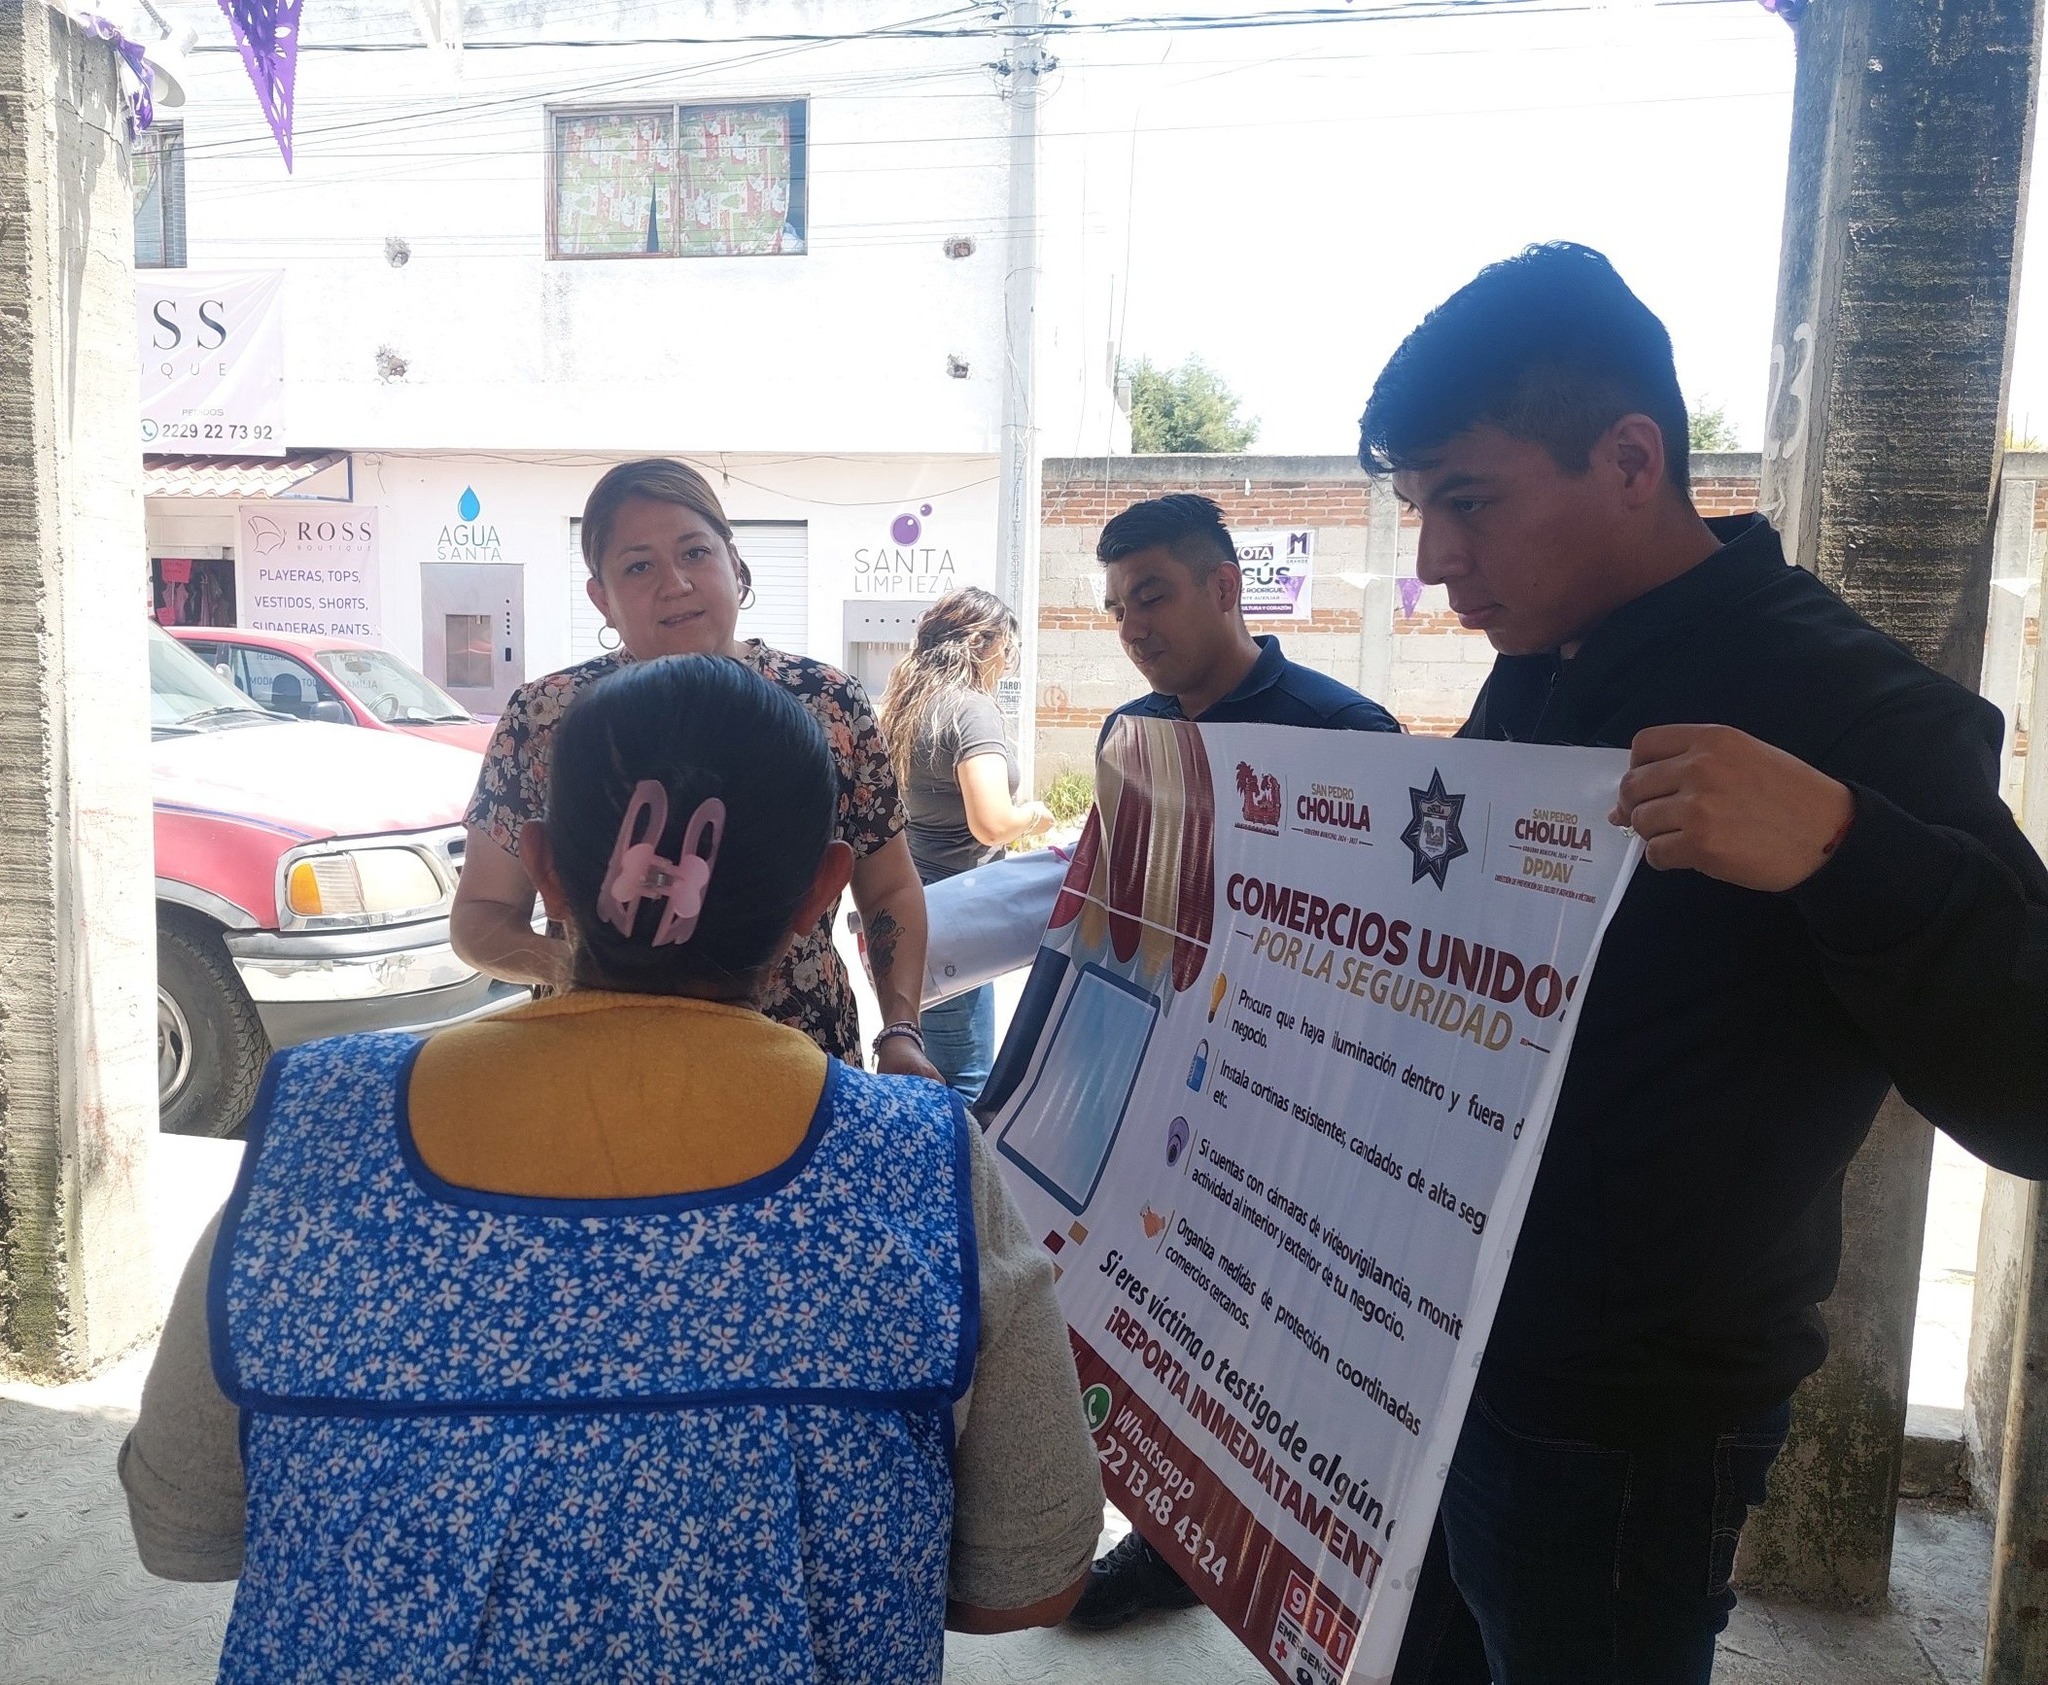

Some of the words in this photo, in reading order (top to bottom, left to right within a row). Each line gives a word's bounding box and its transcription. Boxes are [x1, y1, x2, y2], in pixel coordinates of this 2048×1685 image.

[153, 300, 228, 350] SS
[141, 362, 227, 380] IQUE
[182, 408, 224, 416] PEDOS
[162, 424, 198, 438] 2229
[204, 424, 223, 439] 22
[229, 425, 248, 439] 73
[254, 425, 272, 440] 92
[297, 521, 372, 541] ROSS
[437, 524, 501, 547] AGUA
[437, 546, 502, 561] SANTA
[855, 548, 955, 574] SANTA
[260, 569, 325, 583] PLAYERAS,
[327, 570, 361, 583] TOPS,
[855, 575, 955, 593] LIMPIEZA
[1242, 562, 1290, 585] SÚS
[254, 596, 315, 610] VESTIDOS,
[319, 598, 369, 611] SHORTS,
[252, 621, 327, 636] SUDADERAS,
[331, 623, 373, 635] PANTS.
[344, 680, 378, 689] AMILIA
[1311, 783, 1327, 797] SAN
[1328, 786, 1354, 801] PEDRO
[1297, 795, 1370, 832] CHOLULA
[1532, 808, 1549, 821] SAN
[1550, 811, 1578, 825] PEDRO
[1514, 818, 1592, 851] CHOLULA
[1522, 856, 1574, 884] DPDAV
[1226, 873, 1412, 966] COMERCIOS
[1253, 926, 1303, 970] POR
[1301, 943, 1335, 984] LA
[1335, 956, 1513, 1051] SEGURIDAD
[1231, 1018, 1268, 1049] negocio.
[1238, 988, 1272, 1019] Procura
[1276, 1010, 1296, 1030] que
[1300, 1015, 1326, 1045] haya
[1331, 1030, 1398, 1078] iluminación
[1401, 1064, 1445, 1101] dentro
[1448, 1090, 1461, 1113] y
[1467, 1093, 1505, 1132] fuera
[1513, 1117, 1525, 1140] d
[1219, 1059, 1250, 1090] Instala
[1251, 1080, 1290, 1113] cortinas
[1291, 1102, 1347, 1149] resistentes,
[1349, 1137, 1403, 1180] candados
[1407, 1168, 1426, 1194] de
[1428, 1182, 1457, 1212] alta
[1458, 1201, 1489, 1235] seg
[1192, 1168, 1235, 1207] actividad
[1232, 1196, 1244, 1214] al
[1241, 1200, 1280, 1240] interior
[1276, 1229, 1287, 1249] y
[1284, 1236, 1322, 1275] exterior
[1321, 1262, 1334, 1287] de
[1333, 1275, 1349, 1299] tu
[1349, 1288, 1405, 1341] negocio.
[1198, 1138, 1211, 1158] Si
[1209, 1149, 1245, 1183] cuentas
[1246, 1173, 1265, 1197] con
[1266, 1186, 1309, 1227] cámaras
[1308, 1214, 1321, 1238] de
[1322, 1227, 1413, 1308] videovigilancia,
[1417, 1296, 1464, 1341] monit
[1165, 1246, 1212, 1291] comercios
[1209, 1283, 1250, 1330] cercanos.
[1177, 1217, 1215, 1261] Organiza
[1217, 1254, 1256, 1296] medidas
[1261, 1287, 1273, 1312] de
[1274, 1304, 1330, 1363] protección
[1336, 1357, 1421, 1436] coordinadas
[1099, 1249, 1124, 1277] Si
[1115, 1267, 1149, 1306] eres
[1147, 1294, 1204, 1360] víctima
[1201, 1349, 1215, 1371] o
[1215, 1358, 1281, 1434] testigo
[1278, 1419, 1308, 1463] de
[1308, 1453, 1384, 1529] algún
[1113, 1404, 1195, 1501] Whatsapp
[1186, 1384, 1383, 1590] INMEDIATAMENT
[1099, 1434, 1128, 1476] 22
[1124, 1460, 1149, 1498] 13
[1145, 1485, 1174, 1526] 48
[1174, 1515, 1202, 1555] 43
[1199, 1538, 1228, 1587] 24
[1290, 1587, 1348, 1660] 911
[1277, 1620, 1341, 1685] EMEGENCIA
